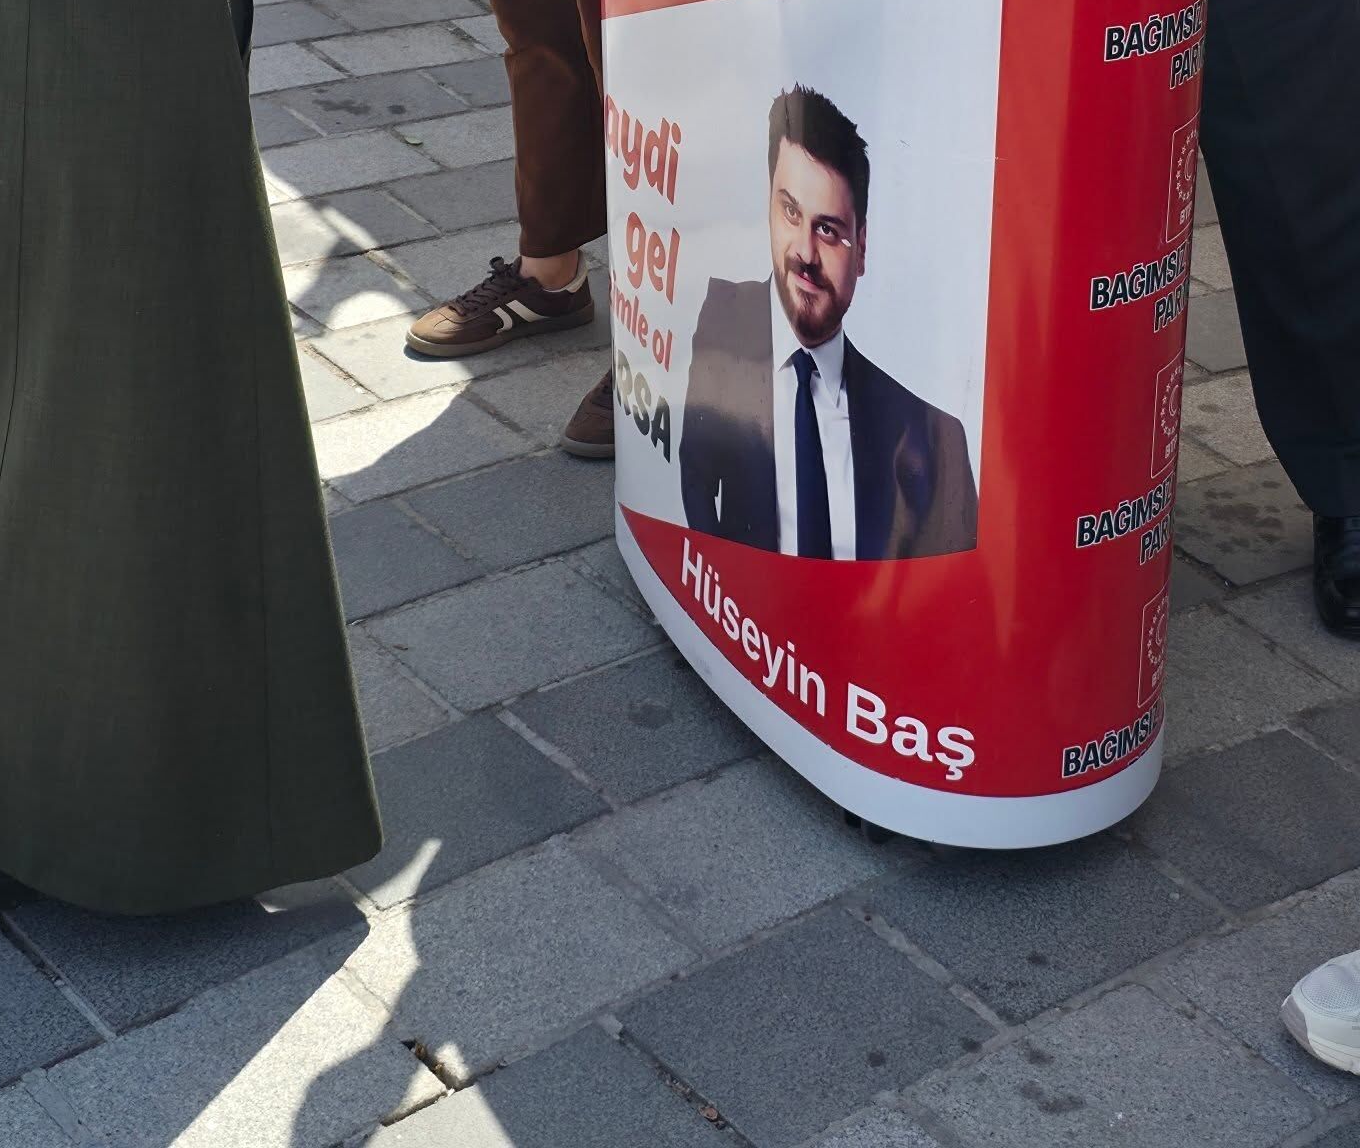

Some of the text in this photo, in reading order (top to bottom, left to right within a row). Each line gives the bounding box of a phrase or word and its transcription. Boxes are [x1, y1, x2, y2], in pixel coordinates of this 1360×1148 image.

[604, 93, 682, 206] aydi
[626, 211, 681, 305] gel
[652, 328, 673, 373] ol
[680, 536, 976, 781] Hüseyin Baş
